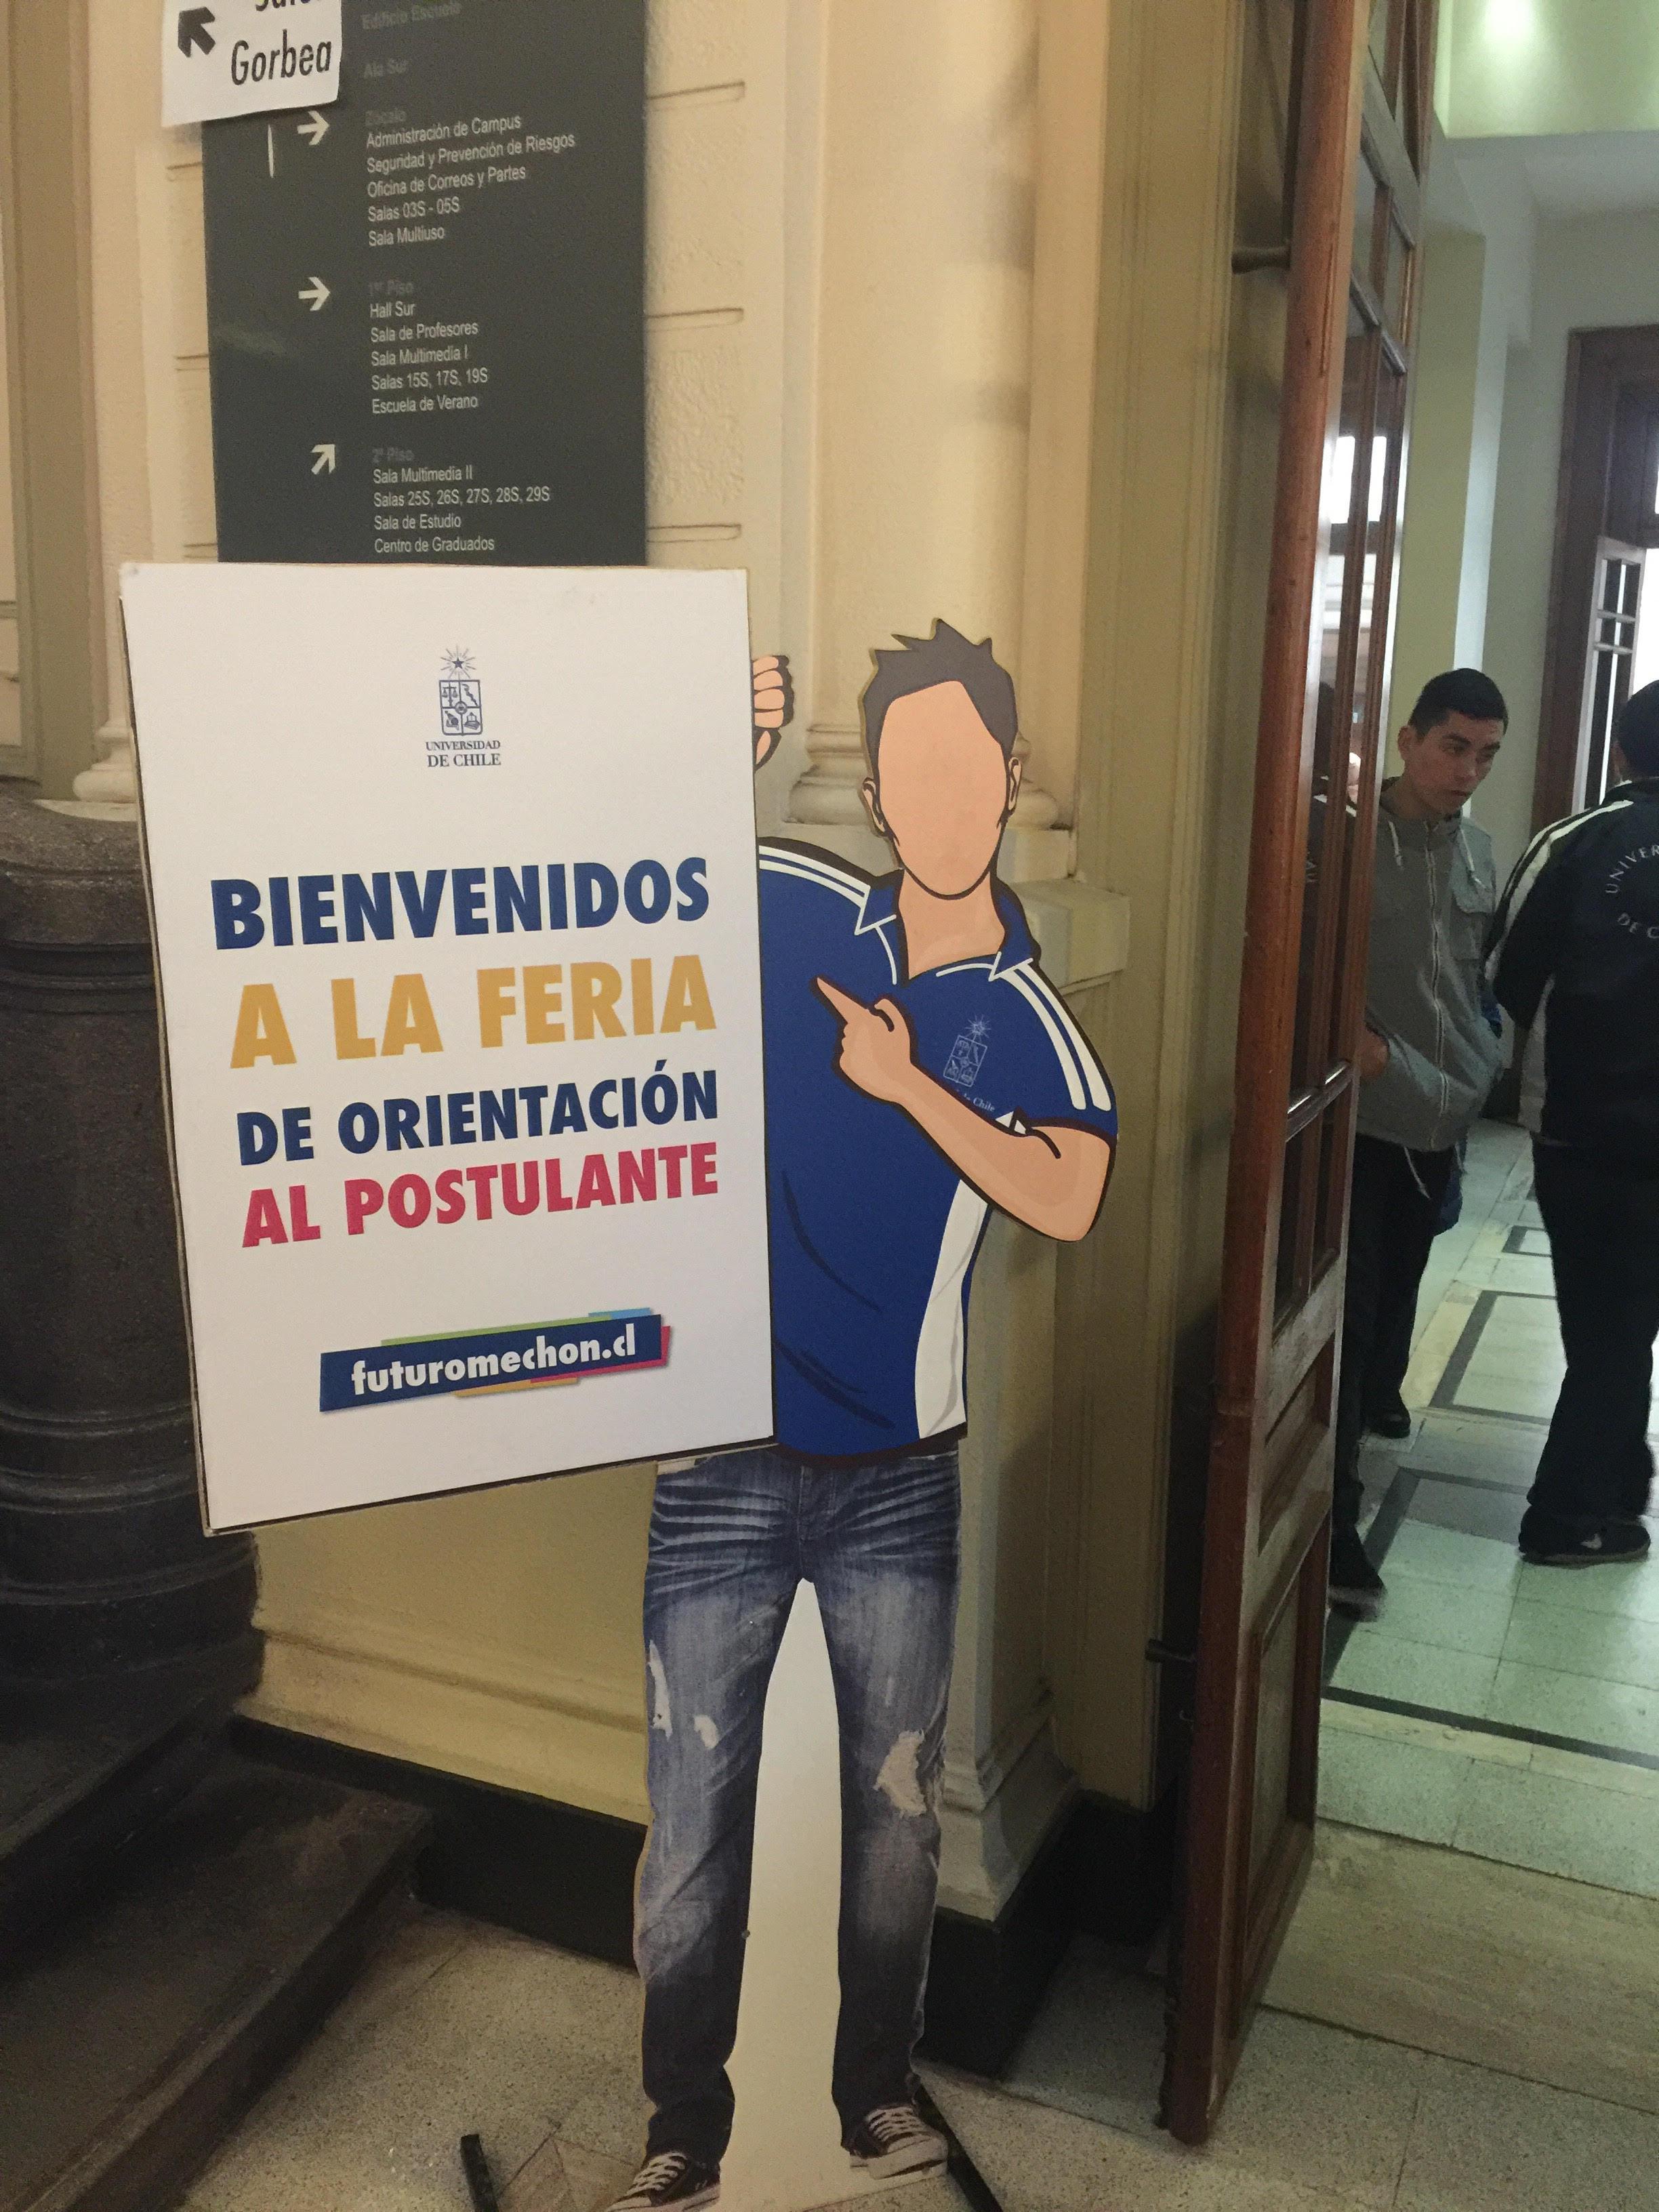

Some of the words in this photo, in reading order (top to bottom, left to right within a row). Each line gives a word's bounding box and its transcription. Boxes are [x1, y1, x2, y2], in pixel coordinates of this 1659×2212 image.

[231, 29, 331, 85] Gorbea
[367, 123, 450, 148] Administración
[453, 121, 468, 136] de
[472, 115, 522, 134] Campus
[367, 151, 425, 175] Seguridad
[428, 152, 434, 169] y
[438, 142, 504, 164] Prevención
[507, 139, 522, 155] de
[526, 134, 575, 153] Riesgos
[367, 180, 406, 197] Oficina
[410, 178, 424, 192] de
[428, 173, 474, 190] Correos
[477, 172, 485, 188] y
[487, 165, 526, 182] Partes
[368, 205, 399, 222] Salas
[369, 230, 394, 246] Sala
[397, 225, 445, 243] Multiuso
[370, 302, 392, 319] Hall
[395, 301, 415, 317] Sur
[371, 327, 396, 343] Sala
[398, 325, 413, 340] de
[416, 322, 479, 339] Profesores
[371, 350, 396, 367] Sala
[399, 346, 461, 364] Multimedia
[371, 374, 404, 390] Salas
[407, 372, 432, 389] 15S,
[466, 367, 488, 384] 19S
[372, 397, 416, 414] Escuela
[419, 396, 434, 411] de
[436, 394, 478, 410] Verano
[373, 468, 398, 484] Sala
[401, 466, 462, 483] Multimedia
[466, 464, 473, 480] II
[373, 492, 405, 508] Salas
[408, 491, 434, 507] 25S,
[436, 489, 463, 506] 26S,
[466, 488, 493, 505] 27S,
[496, 487, 523, 504] 28S,
[526, 486, 550, 502] 29S
[374, 515, 398, 530] Sala
[402, 515, 416, 529] de
[419, 513, 462, 529] Estudio
[374, 538, 411, 553] Centro
[414, 537, 428, 552] de
[432, 535, 495, 552] Graduados
[426, 740, 501, 751] UNIVERSIDAD
[427, 754, 450, 767] DE
[453, 754, 501, 766] CHILE
[211, 857, 710, 949] BIENVENIDOS
[230, 983, 297, 1069] A
[331, 973, 444, 1060] LA
[476, 954, 716, 1048] FERIA
[237, 1106, 314, 1166] DE
[337, 1059, 718, 1154] ORIENTACIÓN
[972, 1097, 995, 1112] Chile
[242, 1185, 321, 1248] AL
[344, 1141, 718, 1235] POSTULANTE
[350, 1323, 636, 1396] futuromechon.cl
